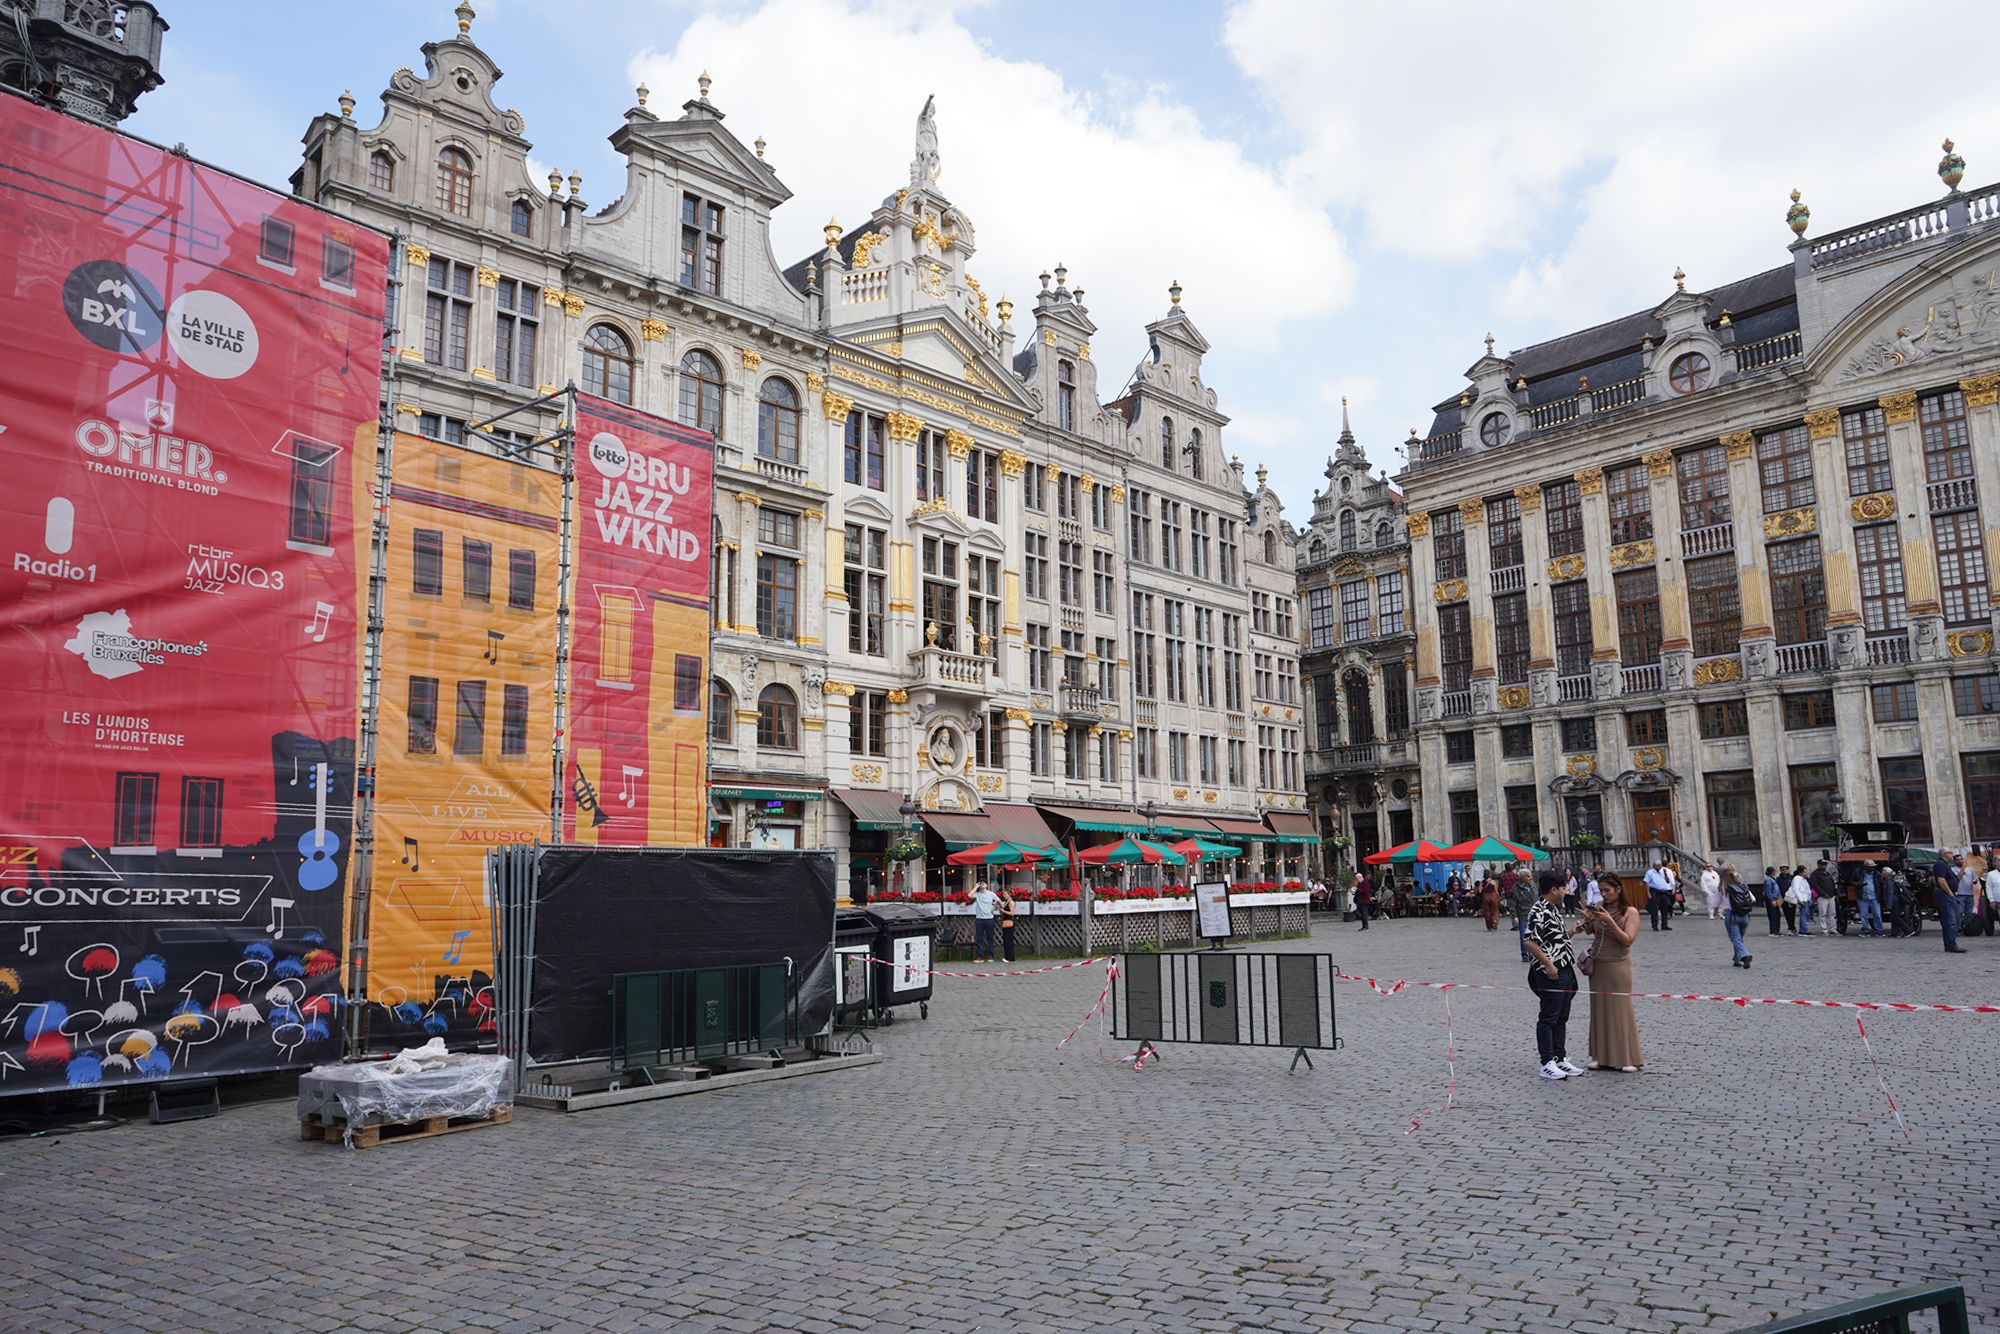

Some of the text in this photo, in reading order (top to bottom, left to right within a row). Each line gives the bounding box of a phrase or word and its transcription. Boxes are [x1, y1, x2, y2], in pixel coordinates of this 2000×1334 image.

[82, 298, 146, 336] BXL
[182, 314, 245, 342] LA VILLE
[181, 327, 243, 353] DE STAD
[86, 461, 219, 496] TRADITIONAL BLOND
[627, 451, 690, 495] BRU
[595, 478, 673, 525] JAZZ
[594, 509, 700, 562] WKND
[186, 556, 284, 590] MUSIQ3
[184, 577, 225, 595] JAZZ
[92, 645, 165, 665] Bruxelles
[93, 631, 202, 656] Francophones
[63, 711, 150, 730] LES LUNDIS
[95, 728, 185, 747] D'HORTENSE
[466, 783, 511, 797] ALL
[432, 805, 487, 819] LIVE
[460, 830, 533, 843] MUSIC
[0, 887, 241, 907] CONCERTS
